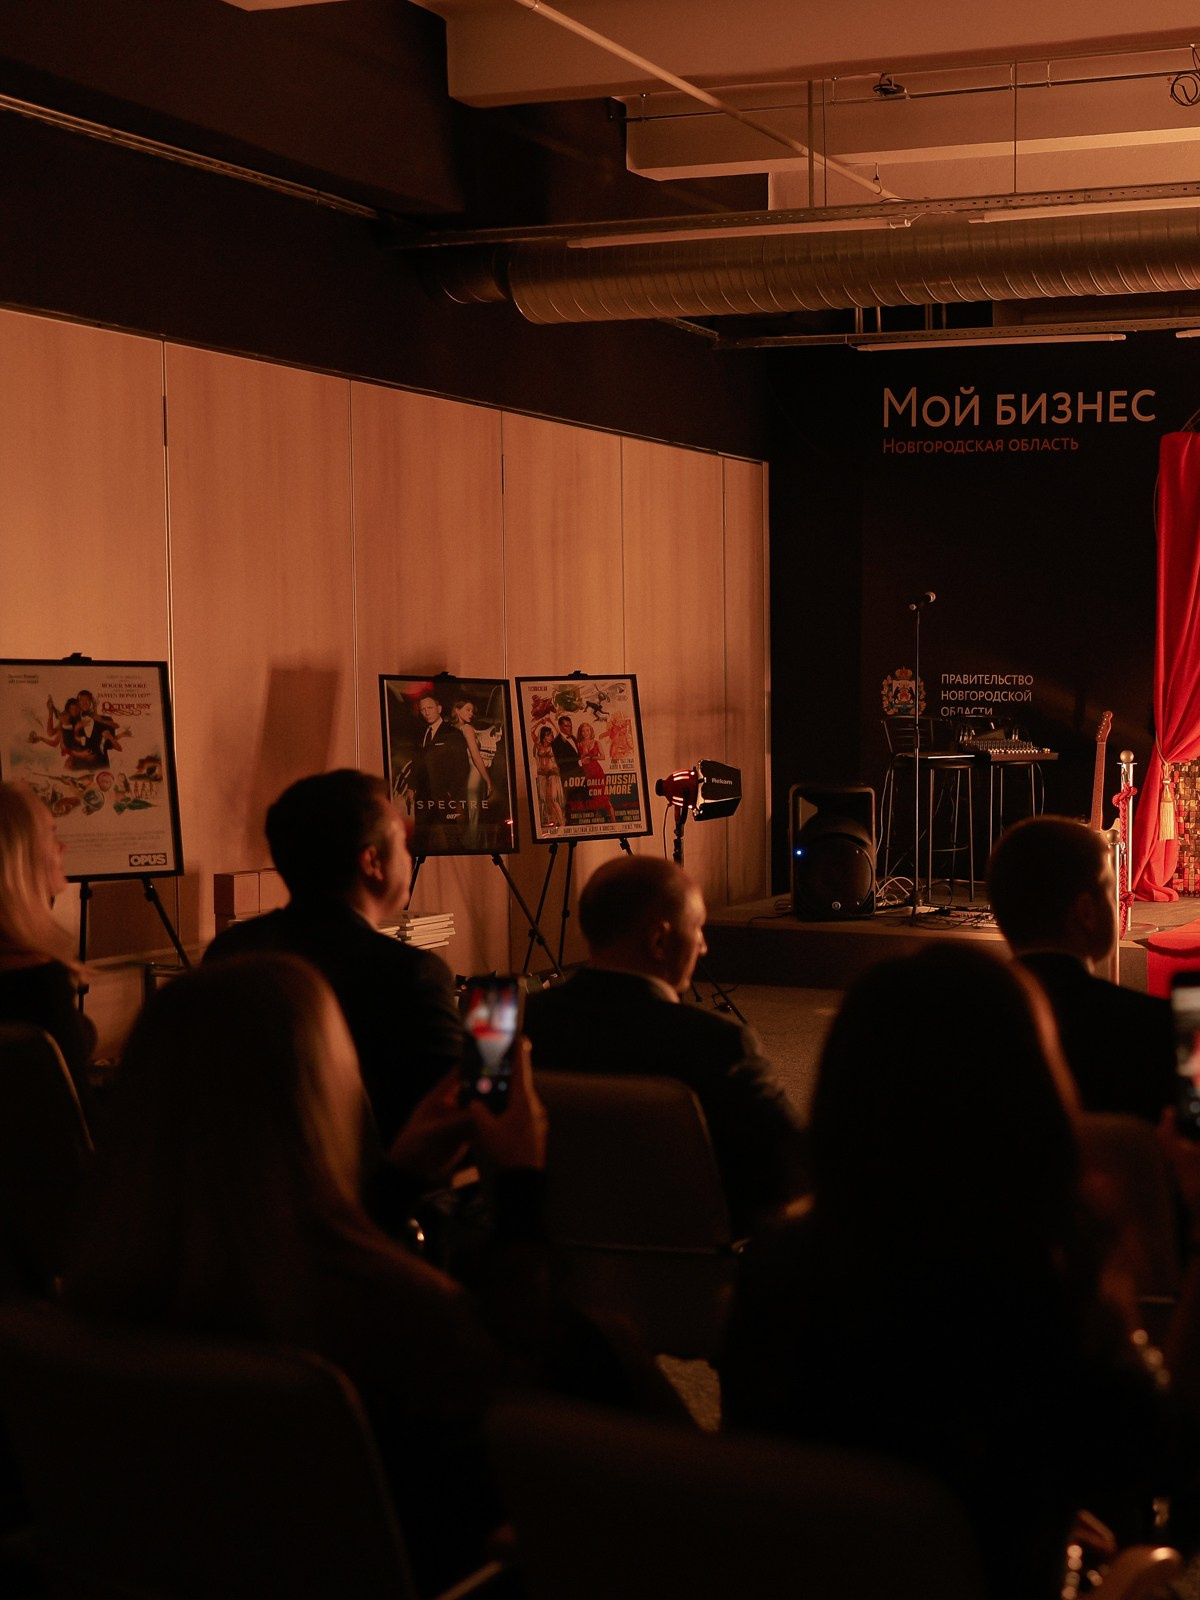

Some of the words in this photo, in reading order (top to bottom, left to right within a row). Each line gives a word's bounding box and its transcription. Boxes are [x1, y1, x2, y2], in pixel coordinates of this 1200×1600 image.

[995, 389, 1157, 426] БИЗНЕС
[1007, 437, 1080, 452] ОБЛАСТЬ
[941, 673, 1034, 686] ПРАВИТЕЛЬСТВО
[941, 689, 1032, 702] НОВГОРОДСКОЙ
[606, 774, 637, 785] RUSSIA
[604, 784, 632, 795] AMORE
[416, 800, 489, 810] SPECTRE
[130, 854, 166, 866] OPUS
